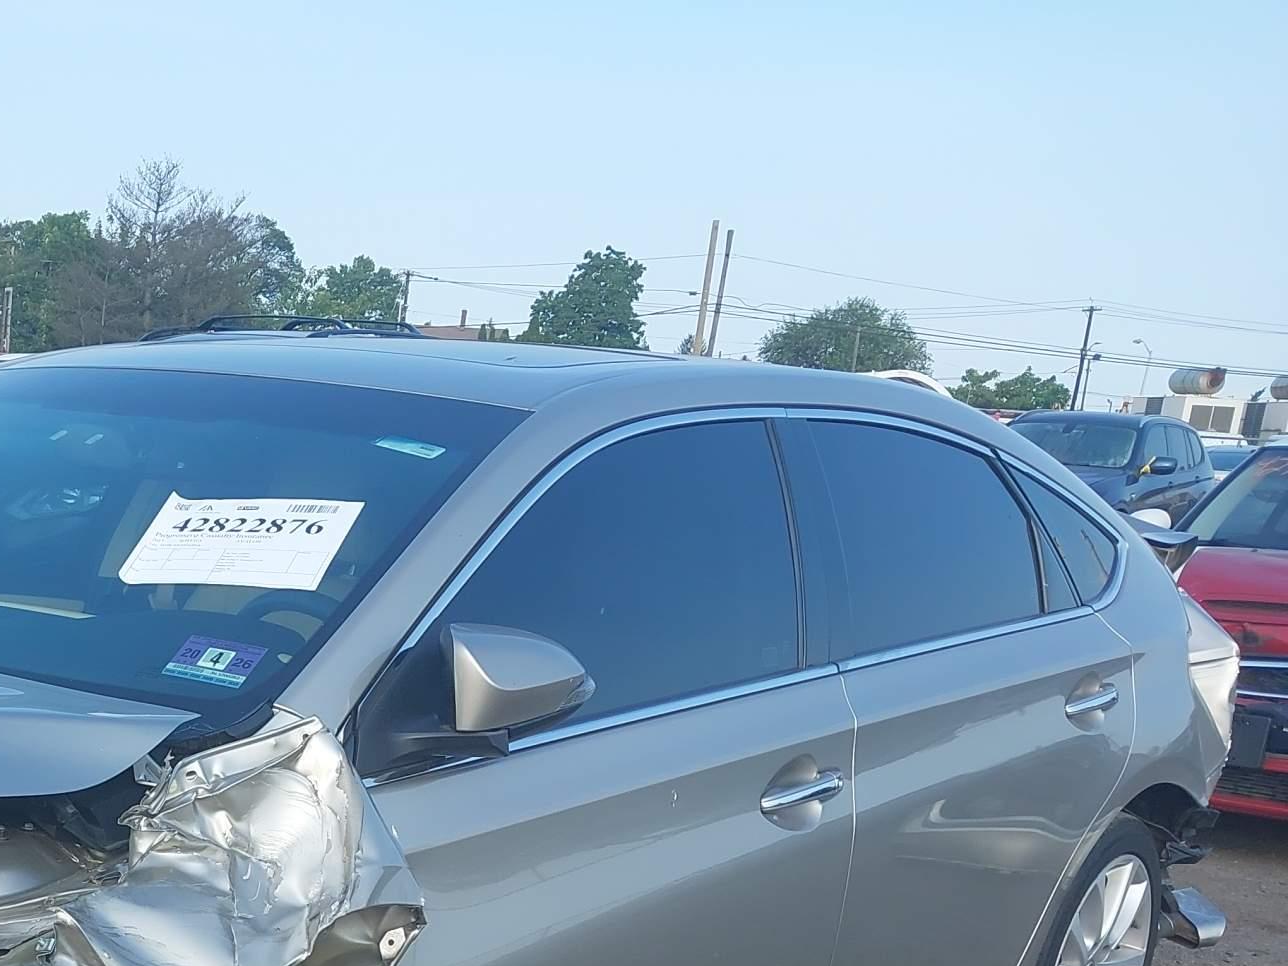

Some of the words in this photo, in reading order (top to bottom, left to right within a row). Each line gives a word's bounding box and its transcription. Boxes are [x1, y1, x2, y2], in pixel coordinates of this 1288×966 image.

[172, 517, 327, 534] 42822876
[180, 647, 201, 659] 20
[210, 651, 225, 667] 4
[231, 657, 254, 670] 26
